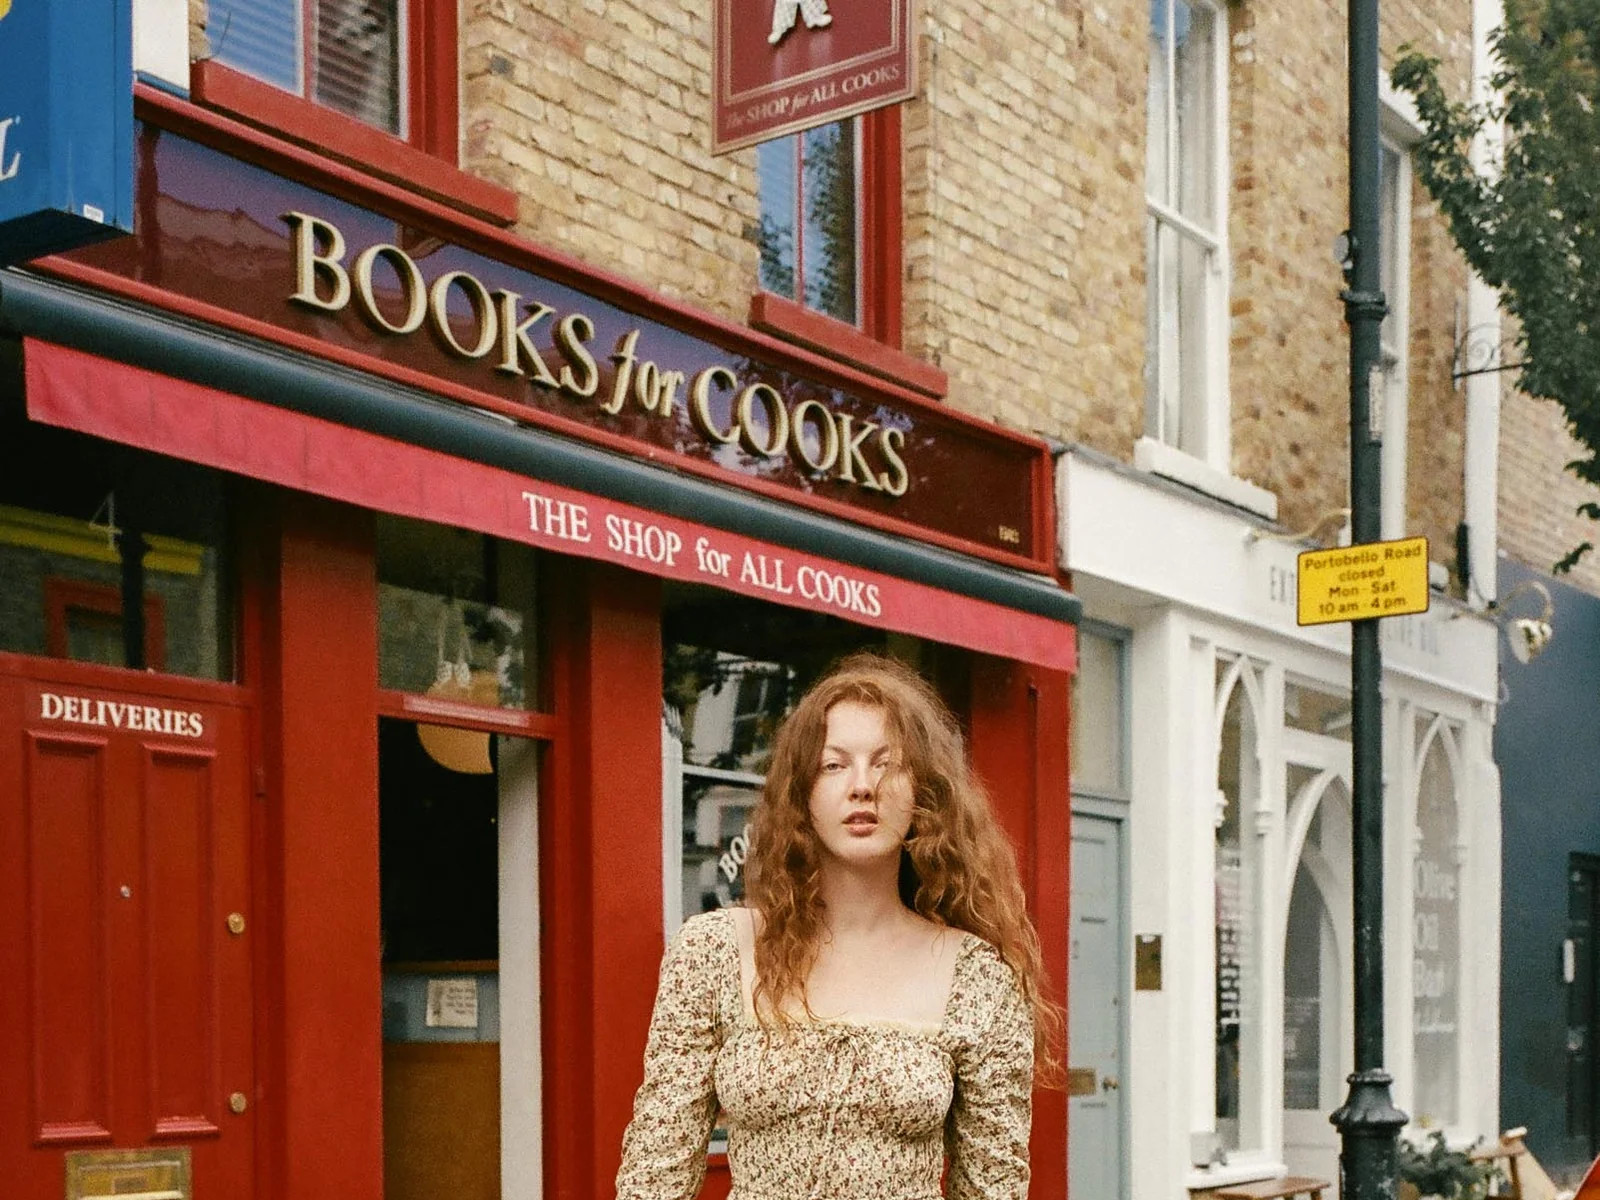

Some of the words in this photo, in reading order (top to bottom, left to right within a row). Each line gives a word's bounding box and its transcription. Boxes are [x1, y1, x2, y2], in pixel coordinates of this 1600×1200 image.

[746, 95, 790, 122] SHOP
[789, 92, 812, 117] for
[810, 81, 840, 105] ALL
[841, 63, 900, 94] COOKS
[281, 210, 599, 397] BOOKS
[600, 329, 685, 418] for
[687, 365, 909, 497] COOKS
[521, 491, 592, 544] THE
[604, 513, 683, 567] SHOP
[694, 536, 732, 579] for
[740, 551, 794, 596] ALL
[797, 564, 883, 618] COOKS
[1303, 550, 1379, 571] Portobello
[1384, 545, 1422, 561] Road
[1328, 585, 1360, 599] Mon
[1370, 579, 1396, 595] Sat
[1337, 565, 1386, 583] closed
[1319, 602, 1335, 616] 10
[1338, 601, 1360, 614] am
[1370, 597, 1381, 610] 4
[1383, 596, 1407, 610] pm
[40, 692, 203, 738] DELIVERIES
